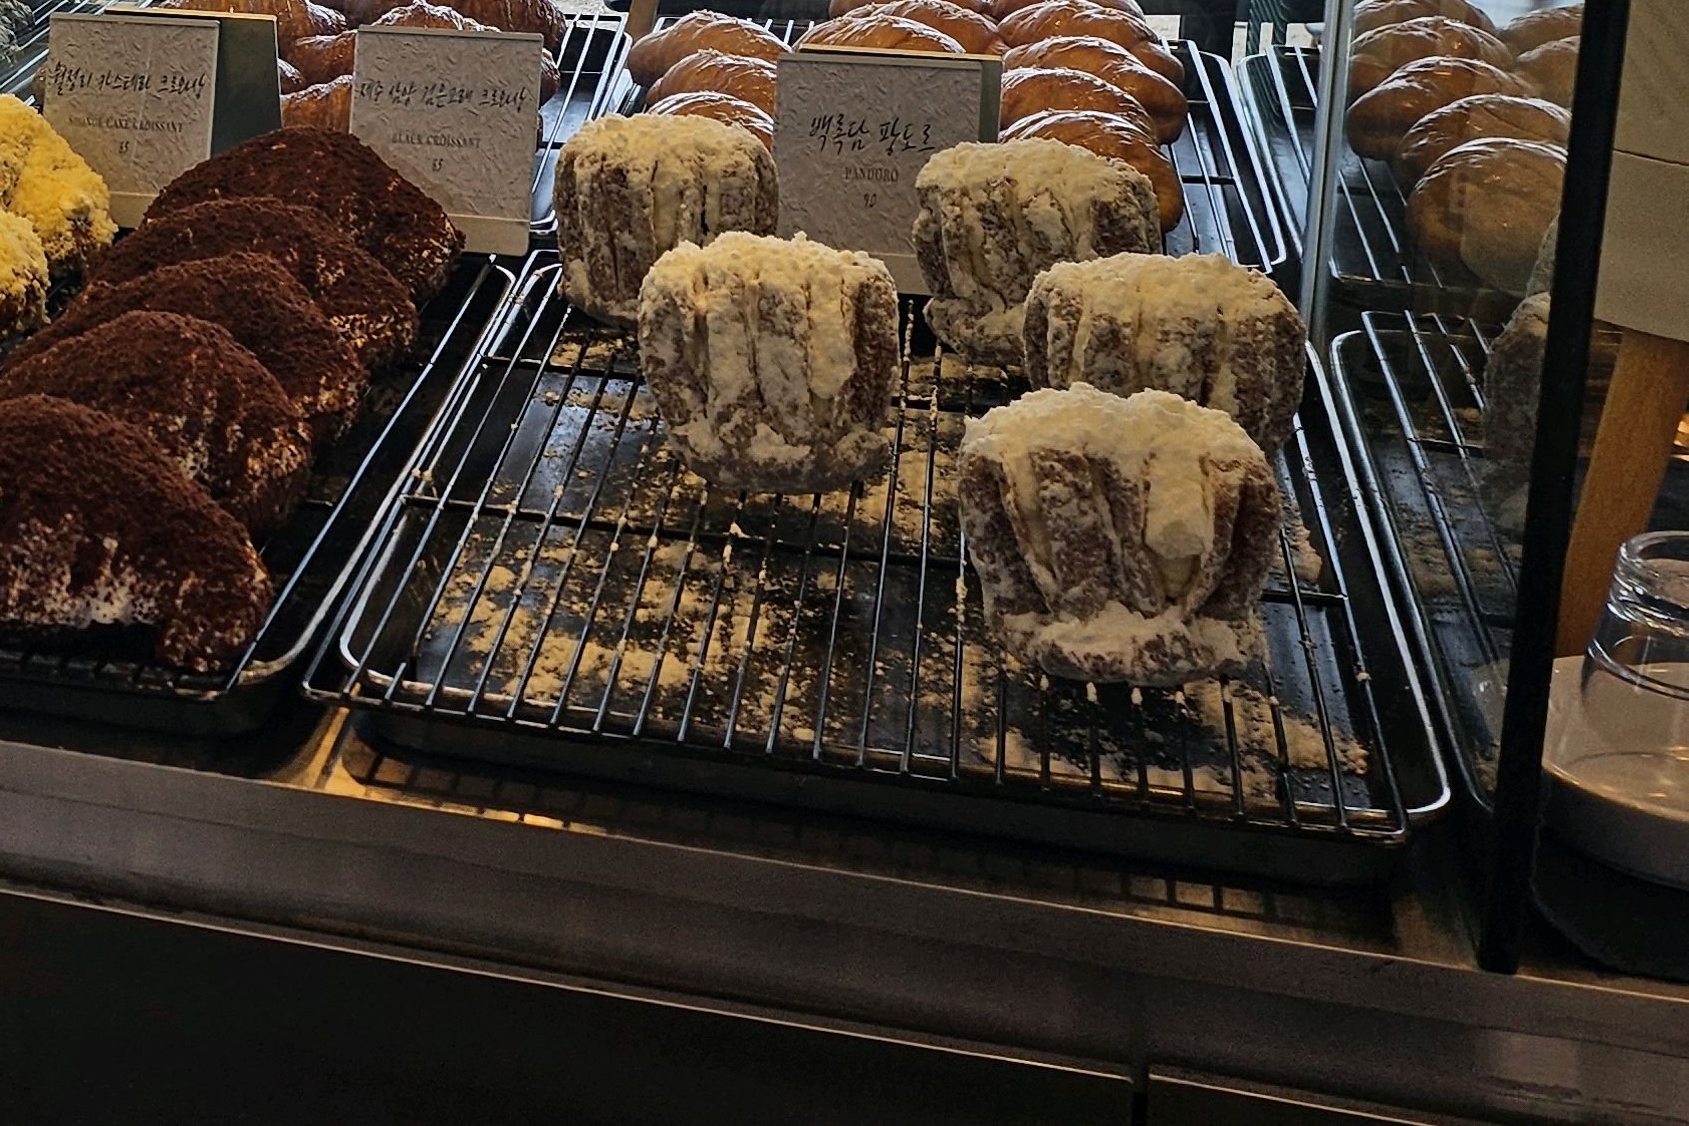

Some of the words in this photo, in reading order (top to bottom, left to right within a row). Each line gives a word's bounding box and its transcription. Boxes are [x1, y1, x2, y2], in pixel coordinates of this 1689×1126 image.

[49, 61, 92, 96] 월정리
[96, 69, 151, 92] 카스테라
[422, 82, 474, 109] 검은모래
[426, 134, 482, 148] CROISSANT
[809, 113, 871, 156] 백록담
[878, 116, 937, 157] 팡도르
[843, 166, 900, 182] PANDORO
